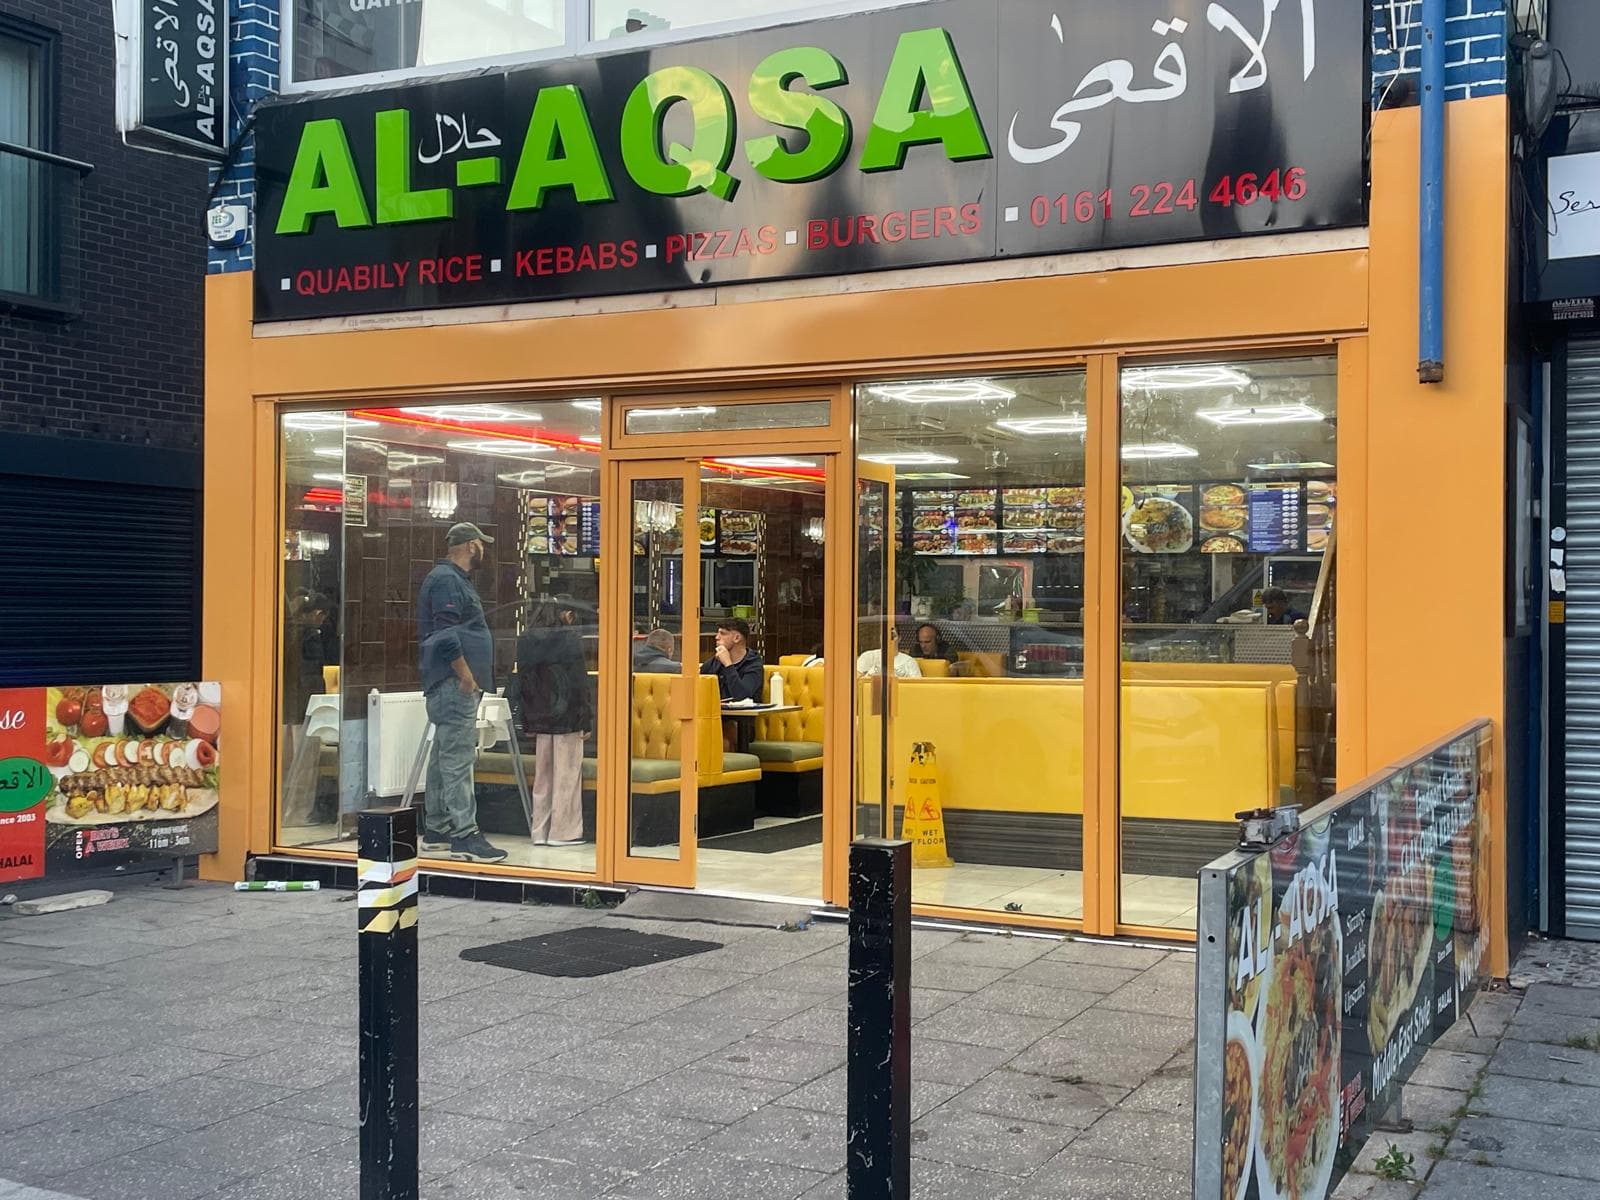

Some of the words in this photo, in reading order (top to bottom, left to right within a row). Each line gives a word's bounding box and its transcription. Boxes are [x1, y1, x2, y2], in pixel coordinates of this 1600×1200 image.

[275, 27, 993, 234] AL-AQSA
[418, 112, 502, 164] حلال
[296, 261, 411, 296] QUABILY
[418, 254, 483, 285] RICE
[514, 240, 639, 277] KEBABS
[665, 224, 778, 263] PIZZAS
[806, 202, 983, 250] BURGERS
[1030, 188, 1112, 229] 0161
[1129, 178, 1198, 217] 224
[1209, 166, 1307, 208] 4646
[75, 830, 83, 859] OPEN
[1372, 1037, 1397, 1101] Middle
[1398, 1014, 1413, 1065] East
